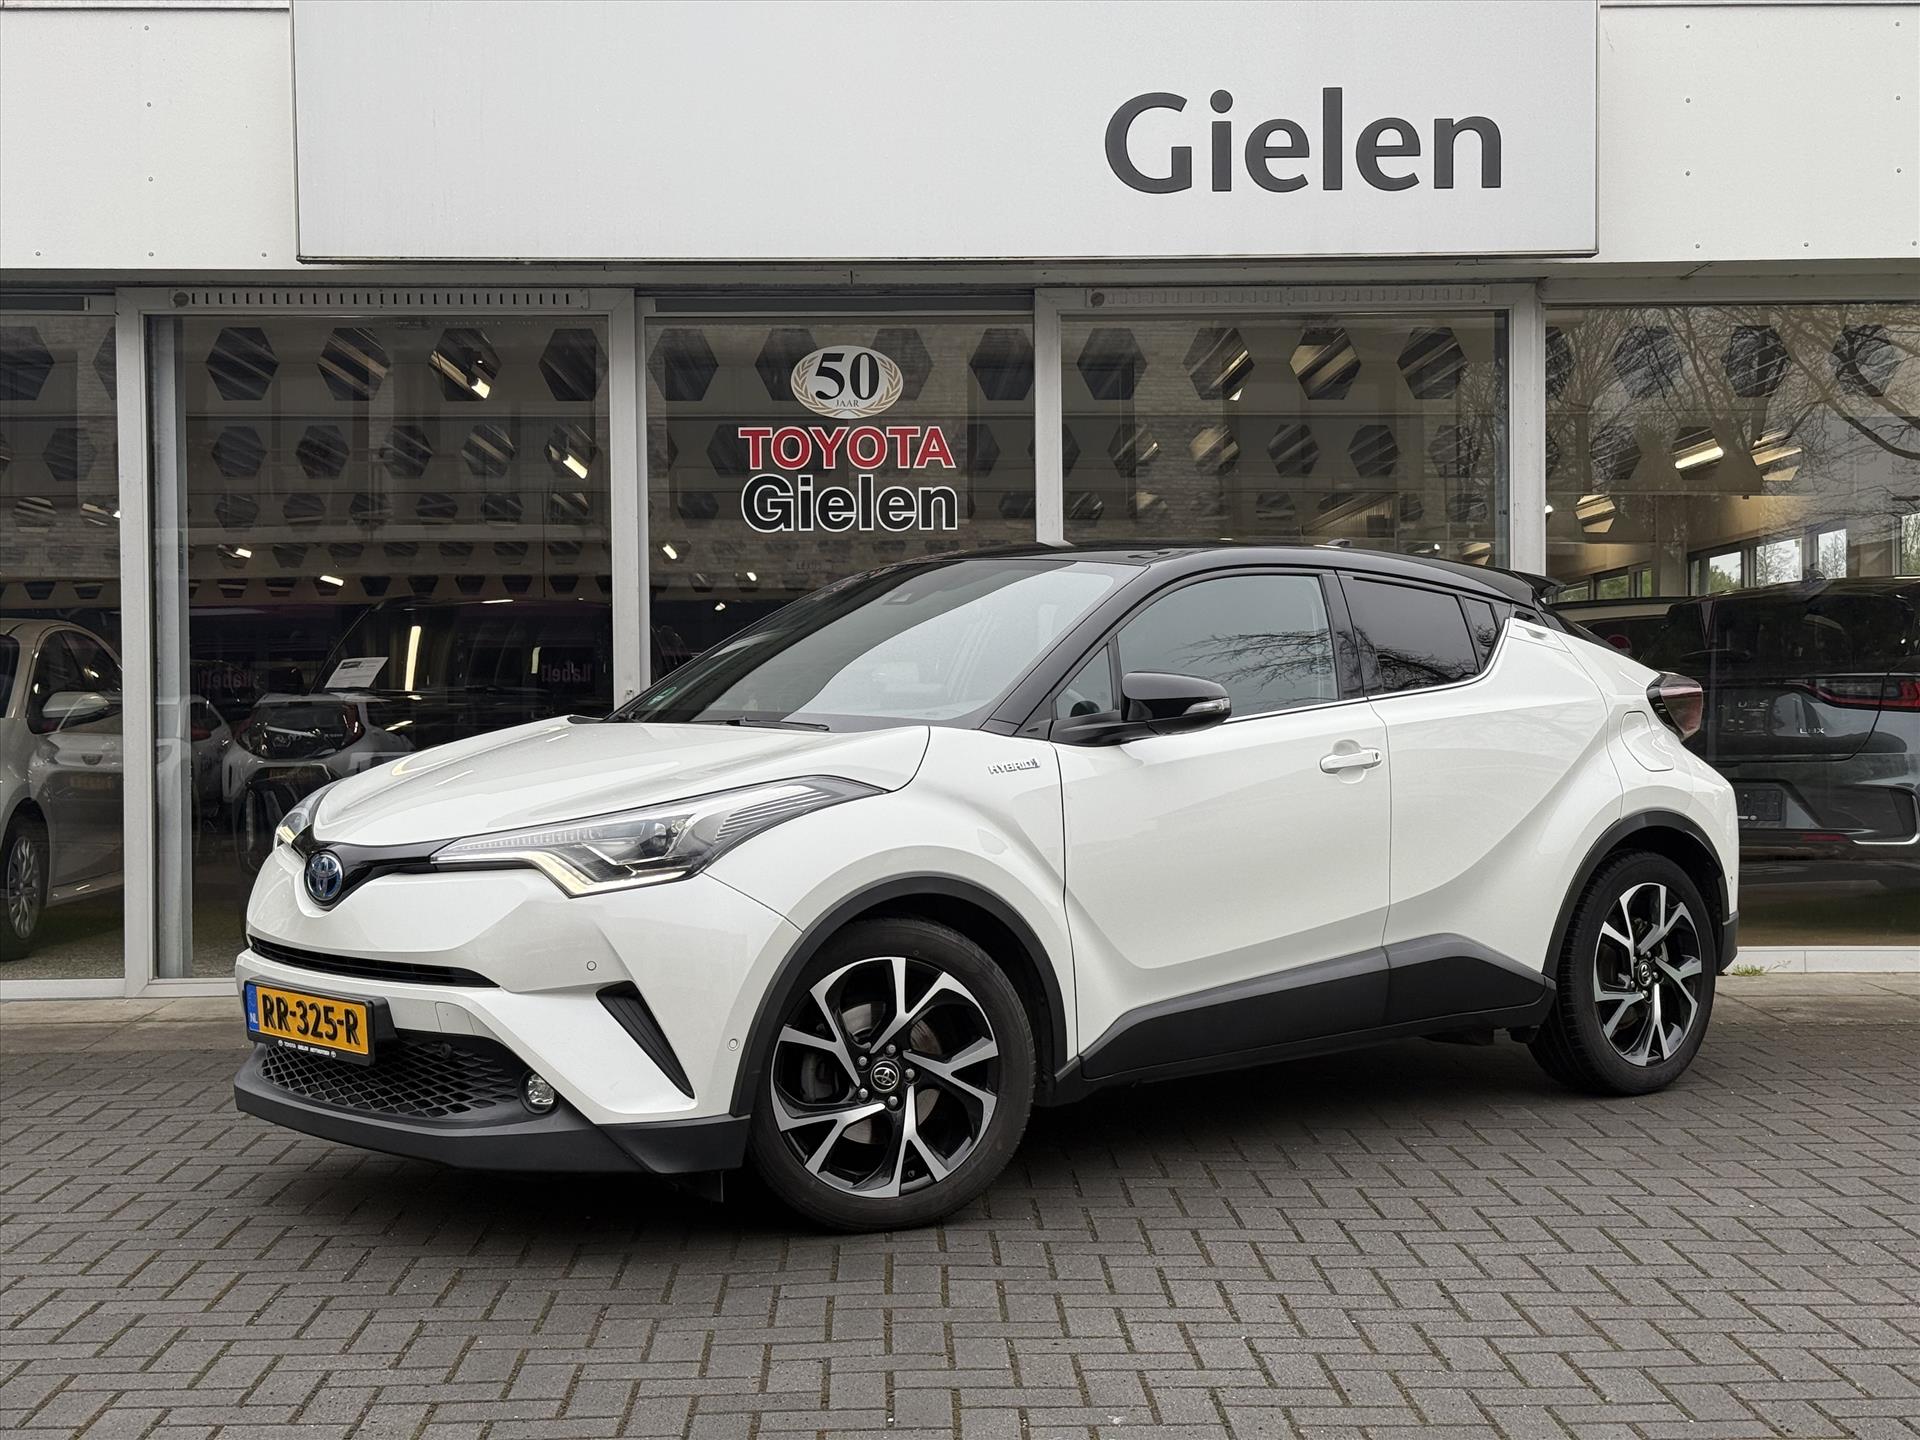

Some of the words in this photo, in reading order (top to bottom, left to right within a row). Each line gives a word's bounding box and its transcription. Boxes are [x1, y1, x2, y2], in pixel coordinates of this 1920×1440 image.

[1104, 87, 1501, 194] Gielen
[815, 352, 880, 400] 50
[835, 399, 860, 408] JAAR
[738, 426, 956, 470] TOYOTA
[741, 473, 958, 533] Gielen
[986, 760, 1035, 775] HYBRID
[250, 1012, 259, 1024] NL
[262, 993, 360, 1046] RR-325-R
